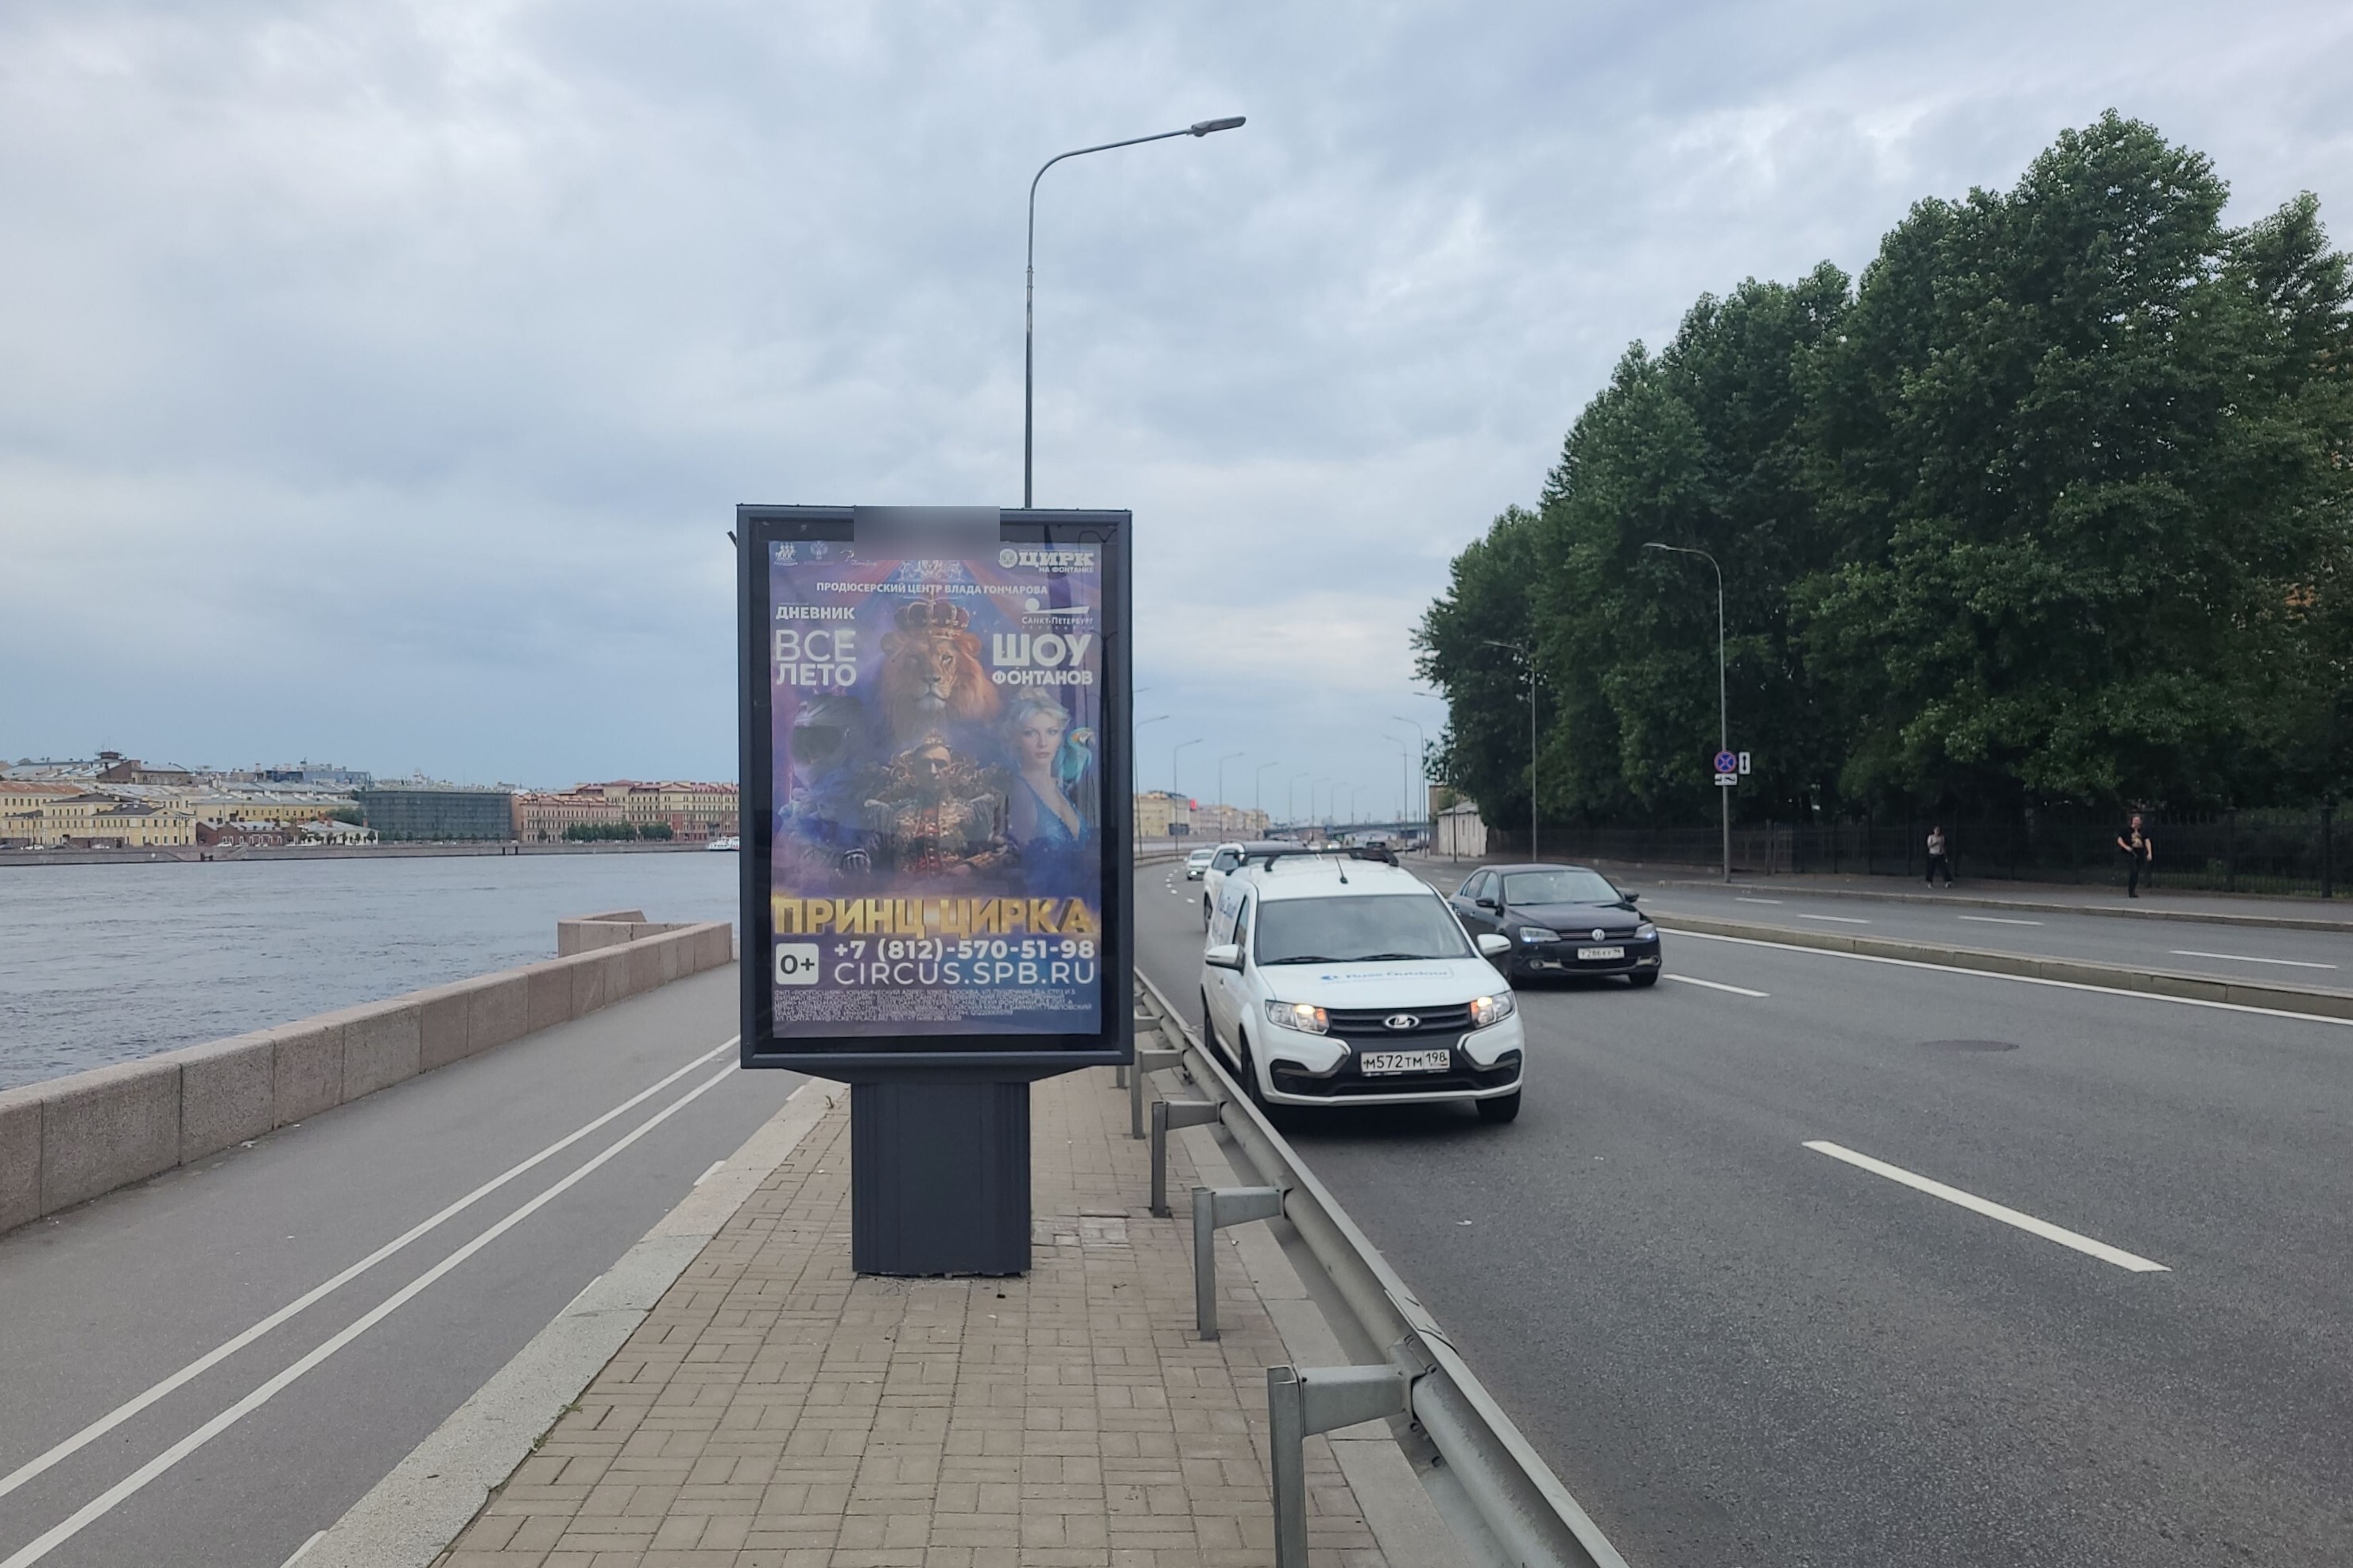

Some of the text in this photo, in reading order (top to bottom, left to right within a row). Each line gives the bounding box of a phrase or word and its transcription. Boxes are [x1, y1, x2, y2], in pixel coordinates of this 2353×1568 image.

[1018, 552, 1094, 567] ЦИРК
[816, 582, 1048, 595] ПРОДЮСЕРСКИЙ ЦЕНТР ВЛАДА ГОНЧАРОВА
[776, 606, 855, 620] ДНЕВНИК
[776, 629, 856, 662] ВСЕ
[993, 633, 1092, 666] ШОУ
[777, 664, 856, 686] ЛЕТО
[992, 670, 1093, 685] ФОНТАНОВ
[774, 899, 1095, 939] ПРИНЦ ЦИРКА
[835, 938, 1095, 962] +7 (812)-570-51-98
[780, 954, 815, 974] 0+
[835, 962, 1095, 985] CIRCUS.SPB.RU
[1366, 1051, 1446, 1069] М572ТМ 198
